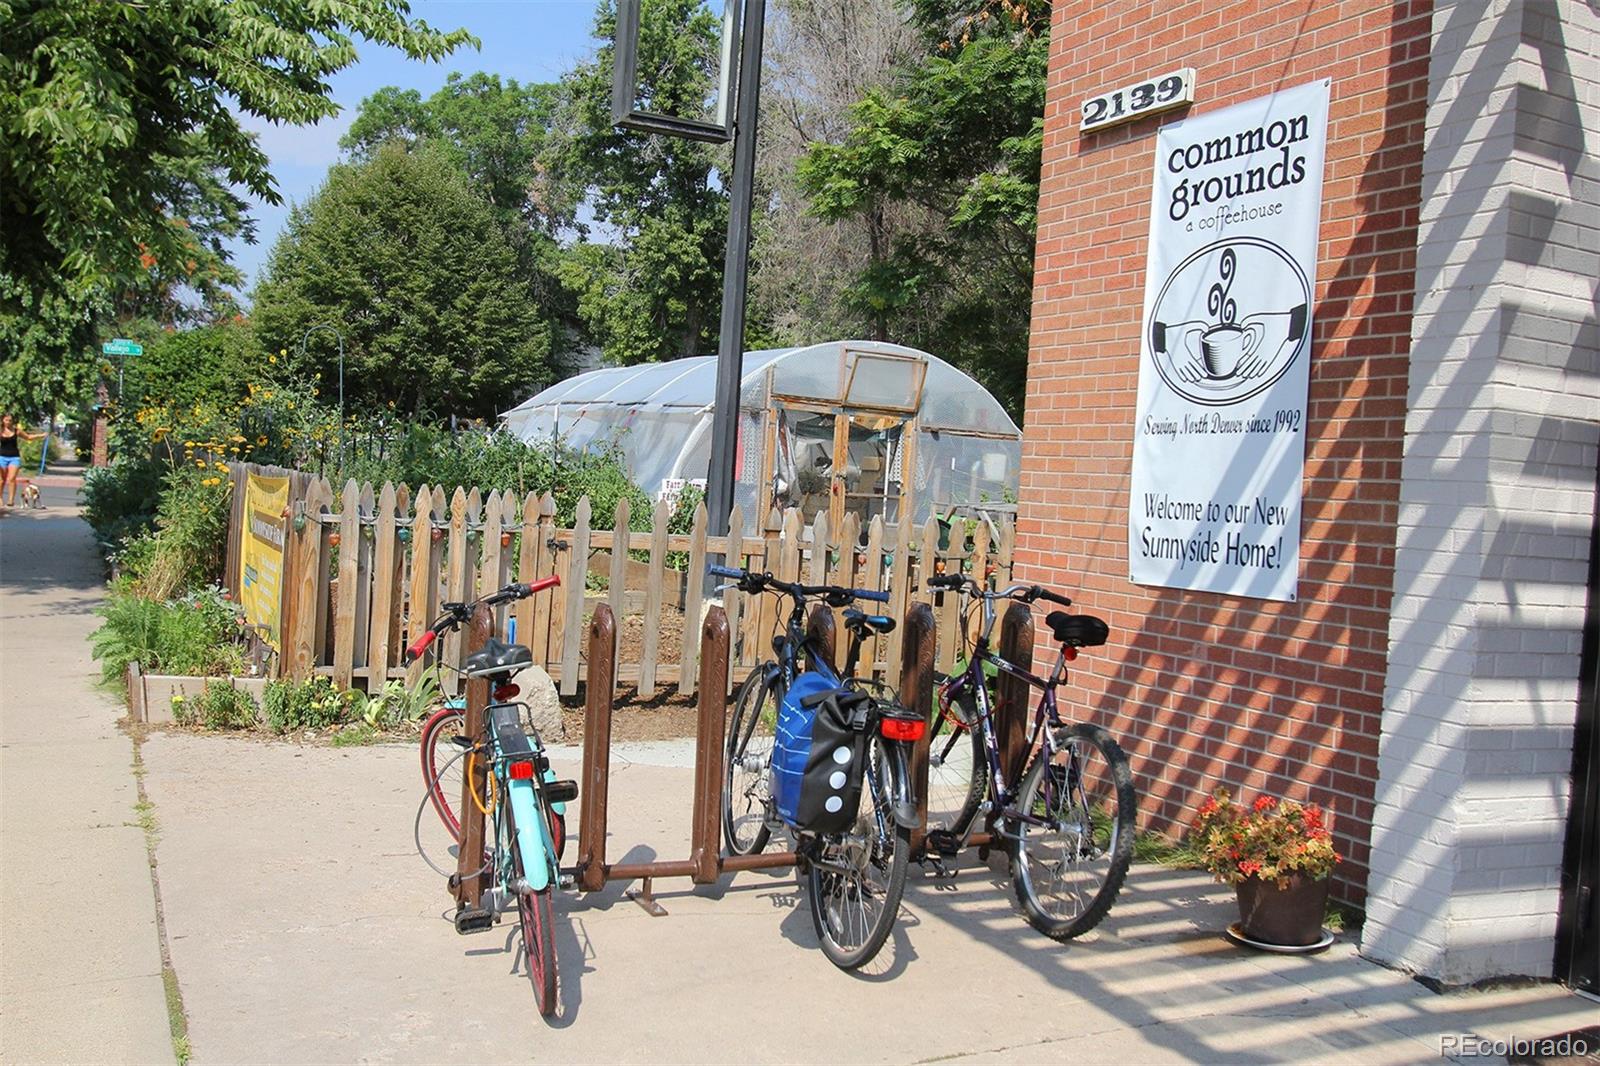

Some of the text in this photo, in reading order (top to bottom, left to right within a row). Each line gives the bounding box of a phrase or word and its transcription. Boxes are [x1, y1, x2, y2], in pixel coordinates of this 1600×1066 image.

[1083, 75, 1183, 126] 2139
[1168, 113, 1309, 174] common
[1169, 146, 1306, 221] grounds
[1185, 202, 1283, 232] a coffeehouse
[1144, 409, 1301, 441] Serving North Denver since 1992
[1144, 493, 1288, 526] Welcome to our New
[1142, 526, 1283, 570] Sunnyside Home!
